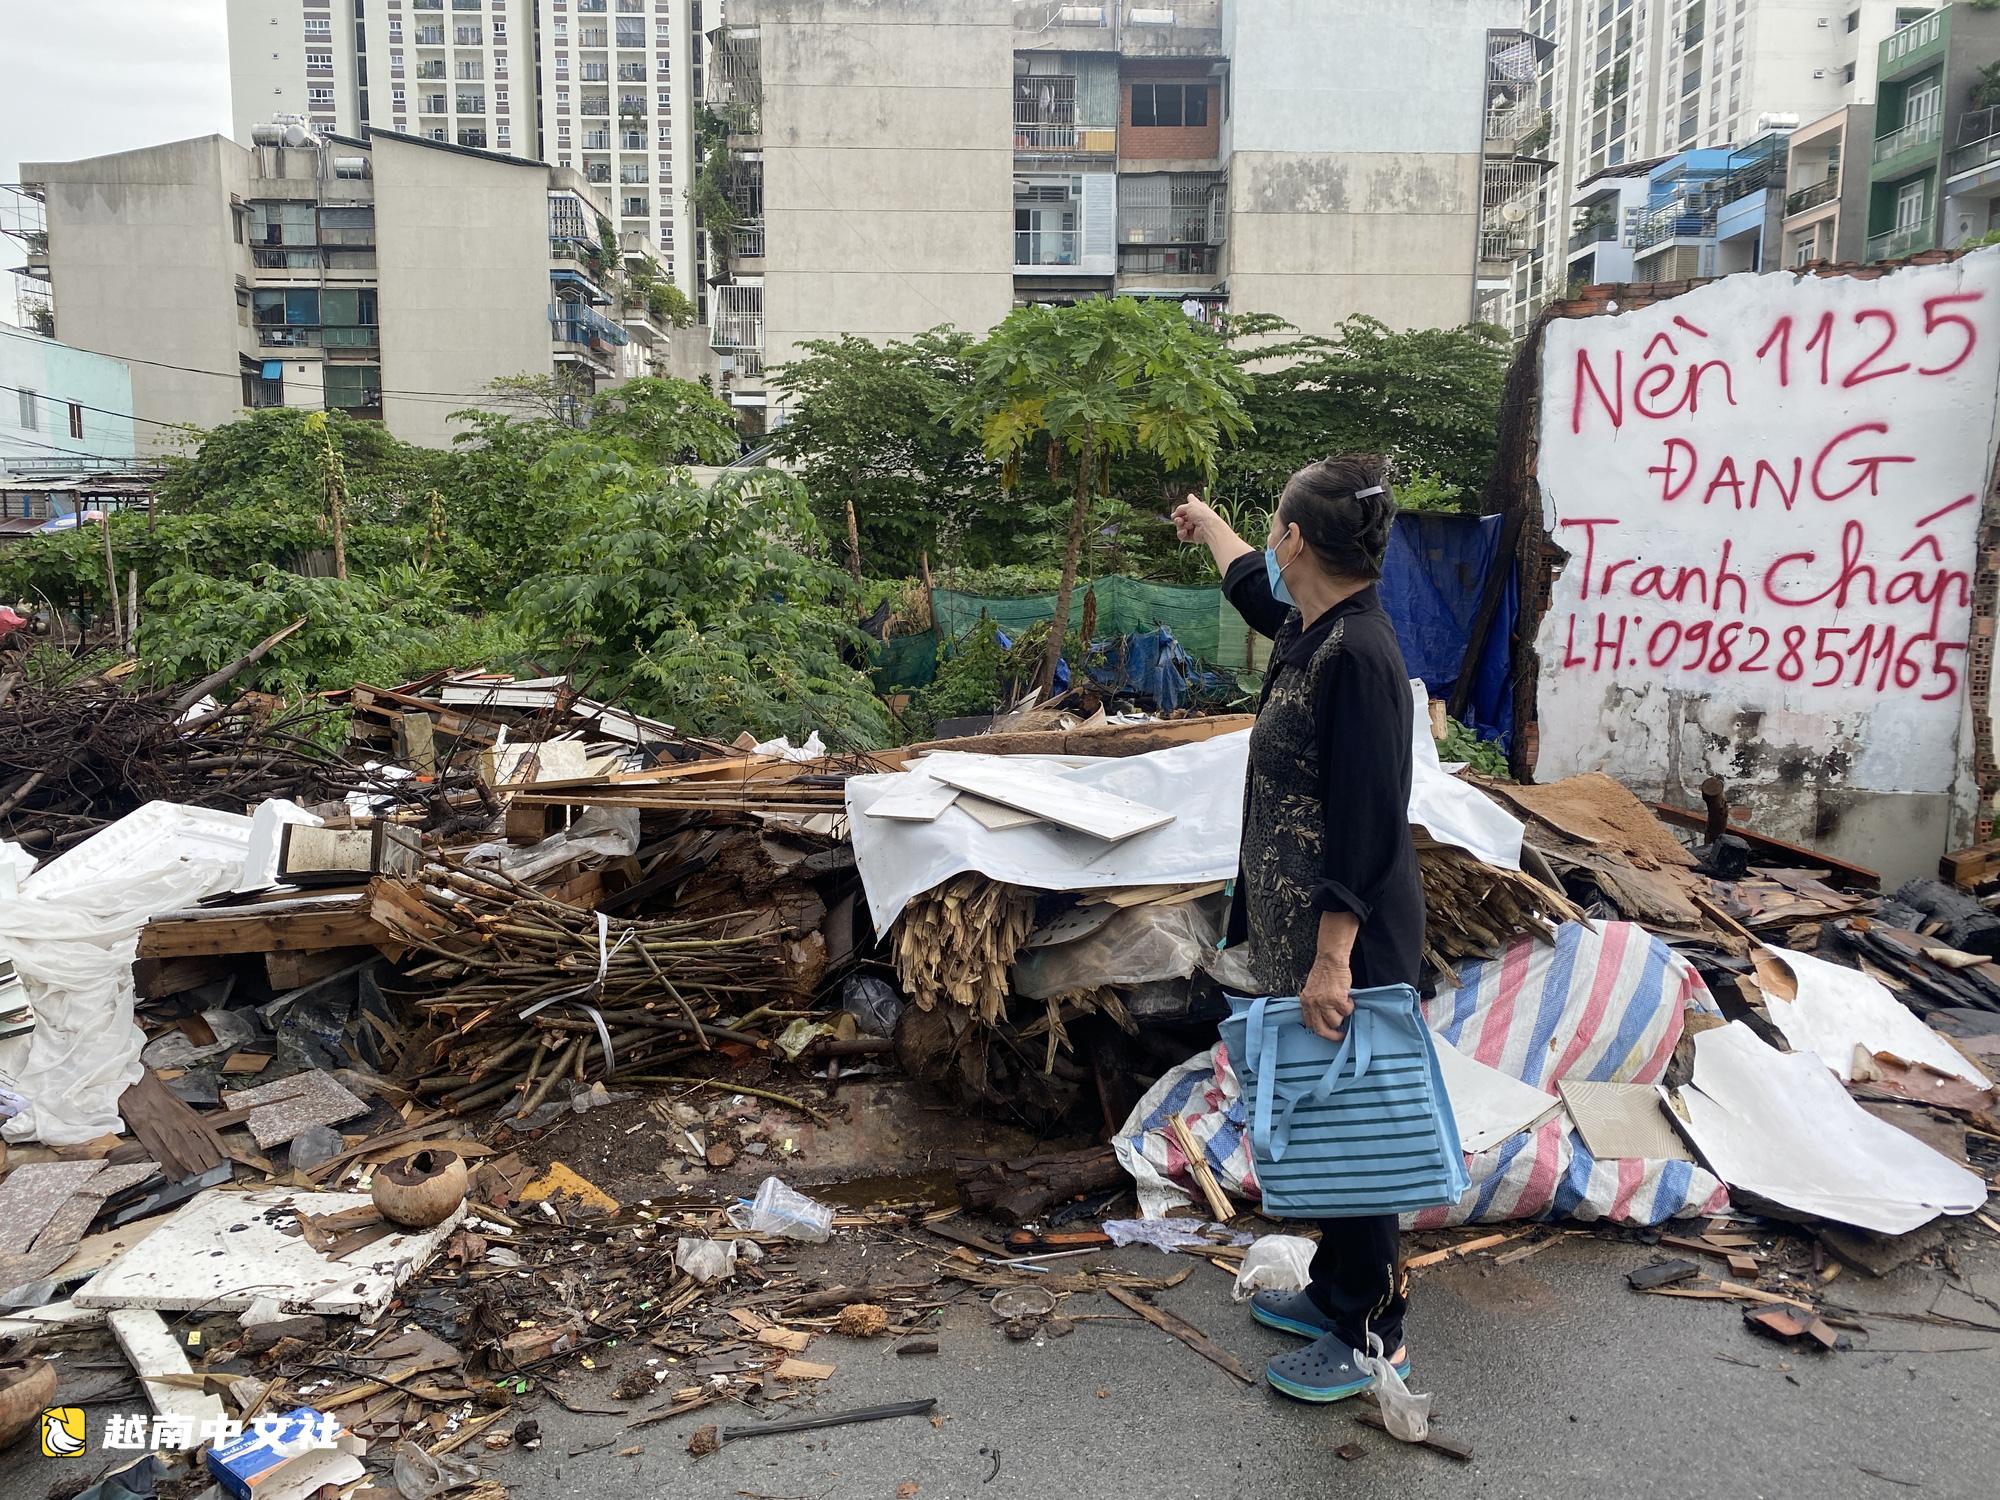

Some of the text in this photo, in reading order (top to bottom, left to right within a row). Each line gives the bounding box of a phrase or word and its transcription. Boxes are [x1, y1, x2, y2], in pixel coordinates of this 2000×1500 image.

[1571, 293, 1984, 435] Nền 1125
[1648, 422, 1916, 512] ĐANG
[1560, 518, 1748, 614] Tranh
